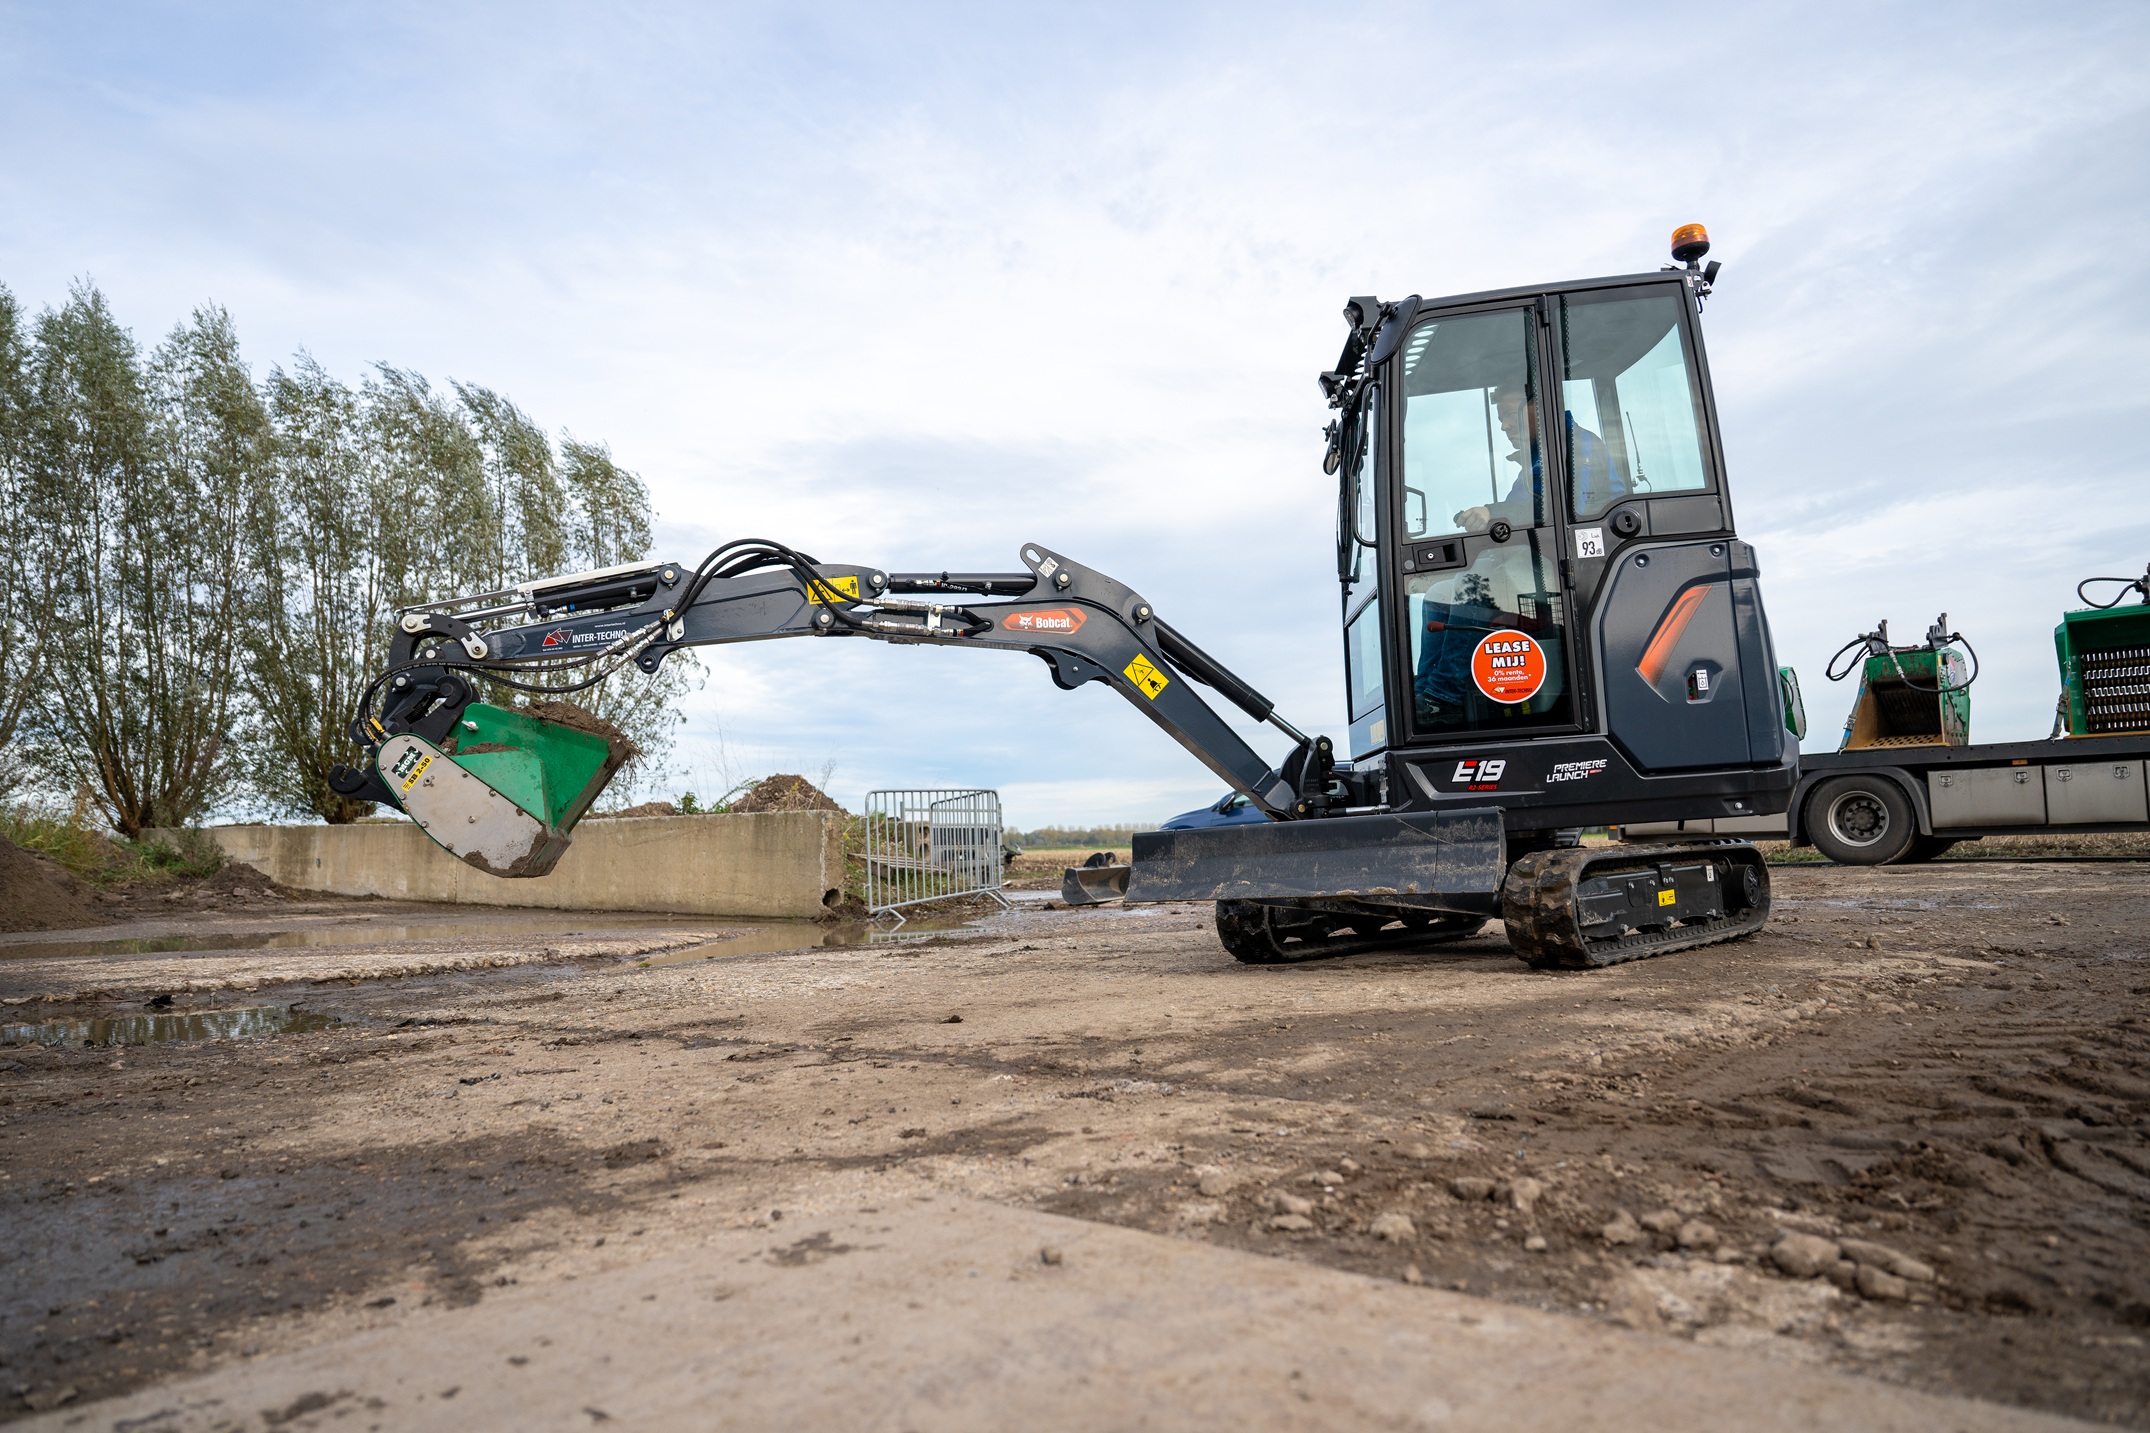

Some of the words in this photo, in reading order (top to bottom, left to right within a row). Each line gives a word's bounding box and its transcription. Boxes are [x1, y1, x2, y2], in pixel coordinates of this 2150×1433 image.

[1582, 541, 1596, 556] 93
[1035, 617, 1071, 629] Bobcat
[1484, 640, 1531, 655] LEASE
[1491, 655, 1526, 669] MIJ!
[408, 773, 418, 785] SB
[416, 757, 431, 775] 2-50
[1451, 759, 1507, 783] E19
[1553, 758, 1608, 774] PREMIERE
[1546, 769, 1589, 783] LAUNCH
